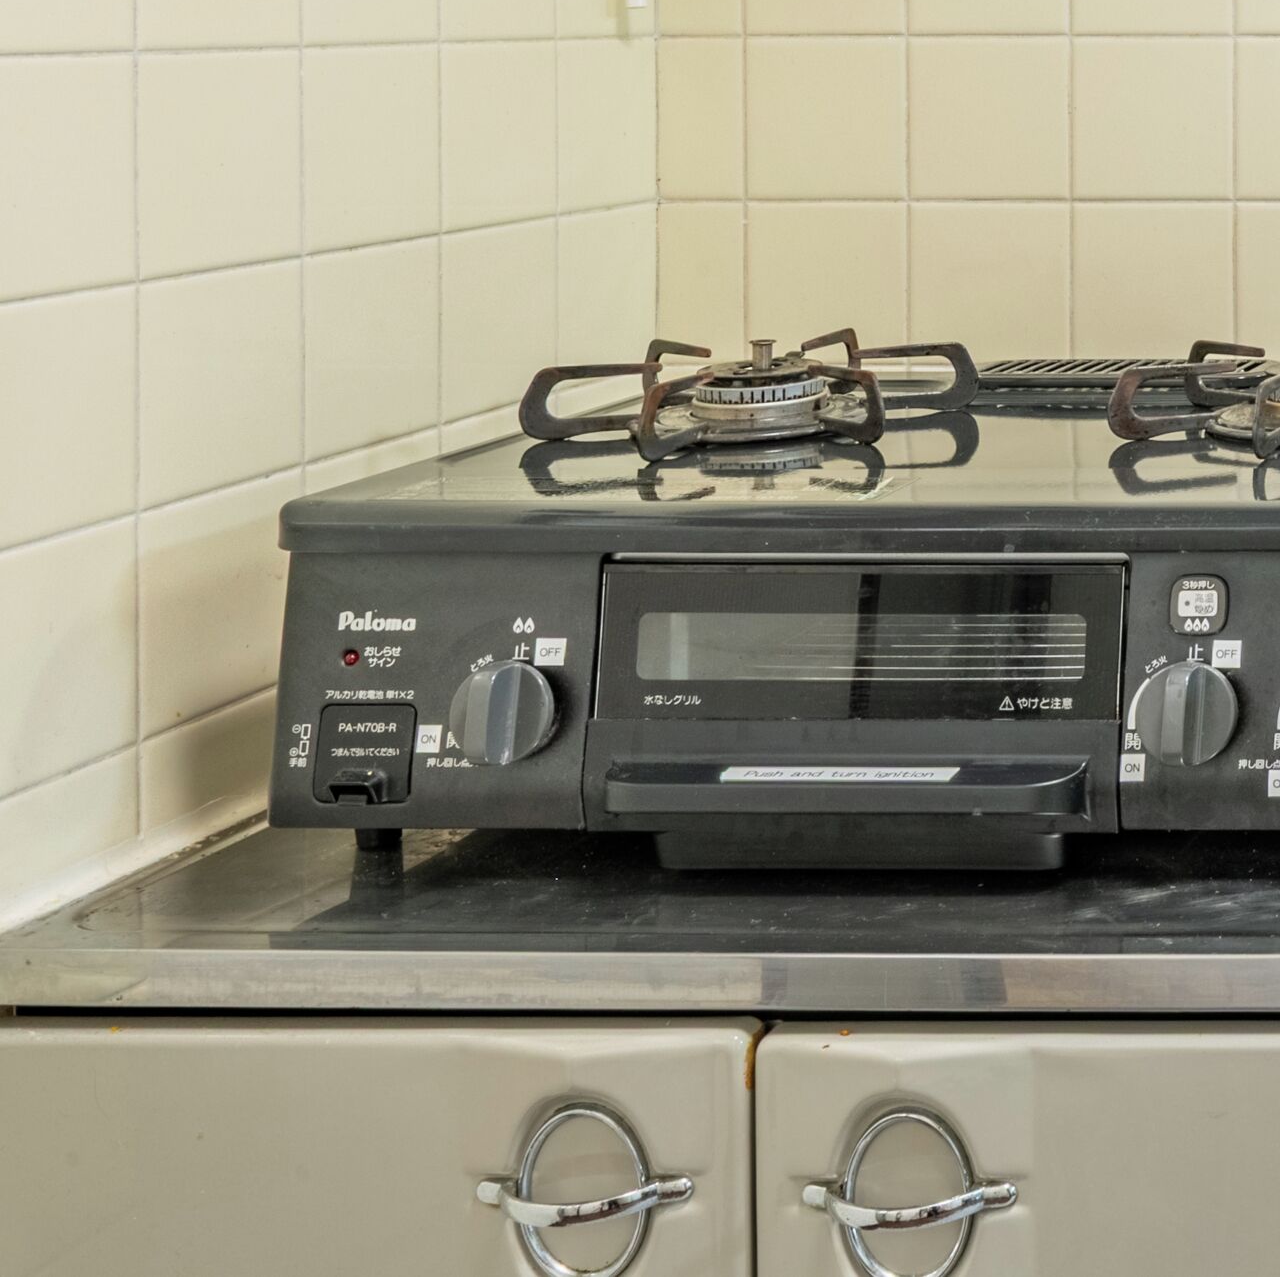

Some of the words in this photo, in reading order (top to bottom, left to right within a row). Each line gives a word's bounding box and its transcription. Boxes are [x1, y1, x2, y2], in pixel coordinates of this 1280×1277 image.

[1182, 580, 1216, 590] 3秒押し
[337, 611, 417, 632] Paloma
[363, 646, 402, 657] おしらせ
[511, 642, 530, 661] 止
[540, 648, 562, 657] OFF
[1186, 643, 1204, 661] 止
[1216, 649, 1238, 659] OFF
[368, 658, 396, 668] サイン
[470, 653, 495, 673] とろ火
[1144, 655, 1169, 674] とろ火
[325, 690, 384, 700] アルカリ乾電池
[643, 695, 701, 706] 水なしグリル
[1016, 696, 1073, 710] やけど注意
[338, 722, 397, 733] PA-N70B-R
[420, 734, 437, 744] ON
[1124, 732, 1142, 751] 開
[331, 747, 400, 757] つまんで引いてください
[289, 758, 307, 768] 手前
[1124, 764, 1141, 773] ON
[744, 770, 784, 778] Push
[790, 770, 825, 778] and
[831, 770, 867, 778] turn
[873, 770, 935, 779] ignition
